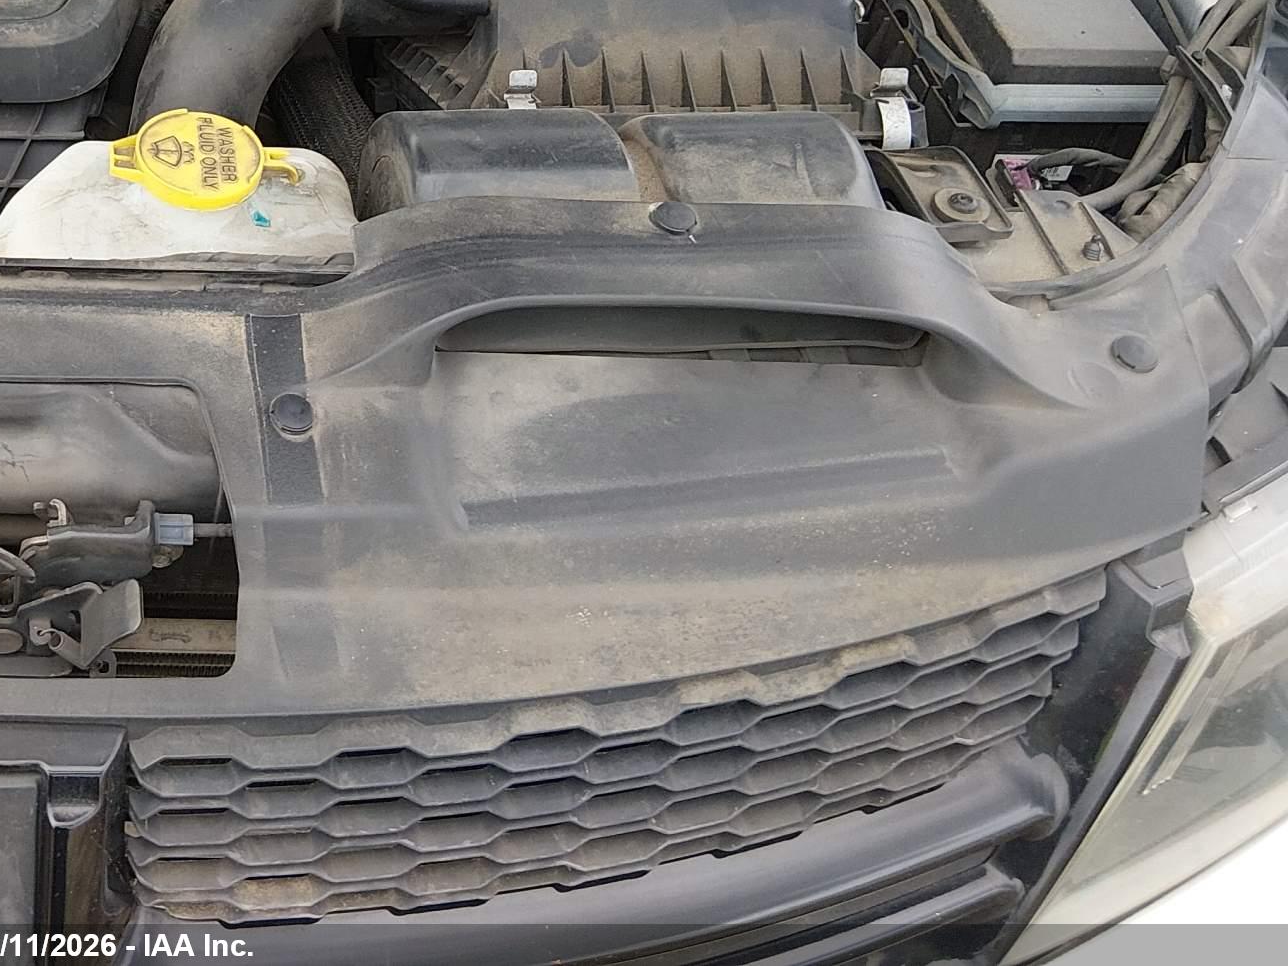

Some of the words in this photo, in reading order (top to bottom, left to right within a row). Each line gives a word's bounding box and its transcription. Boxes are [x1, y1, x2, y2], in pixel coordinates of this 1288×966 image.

[195, 116, 216, 155] FLUID
[199, 156, 220, 193] ONLY
[216, 126, 239, 185] WASHER
